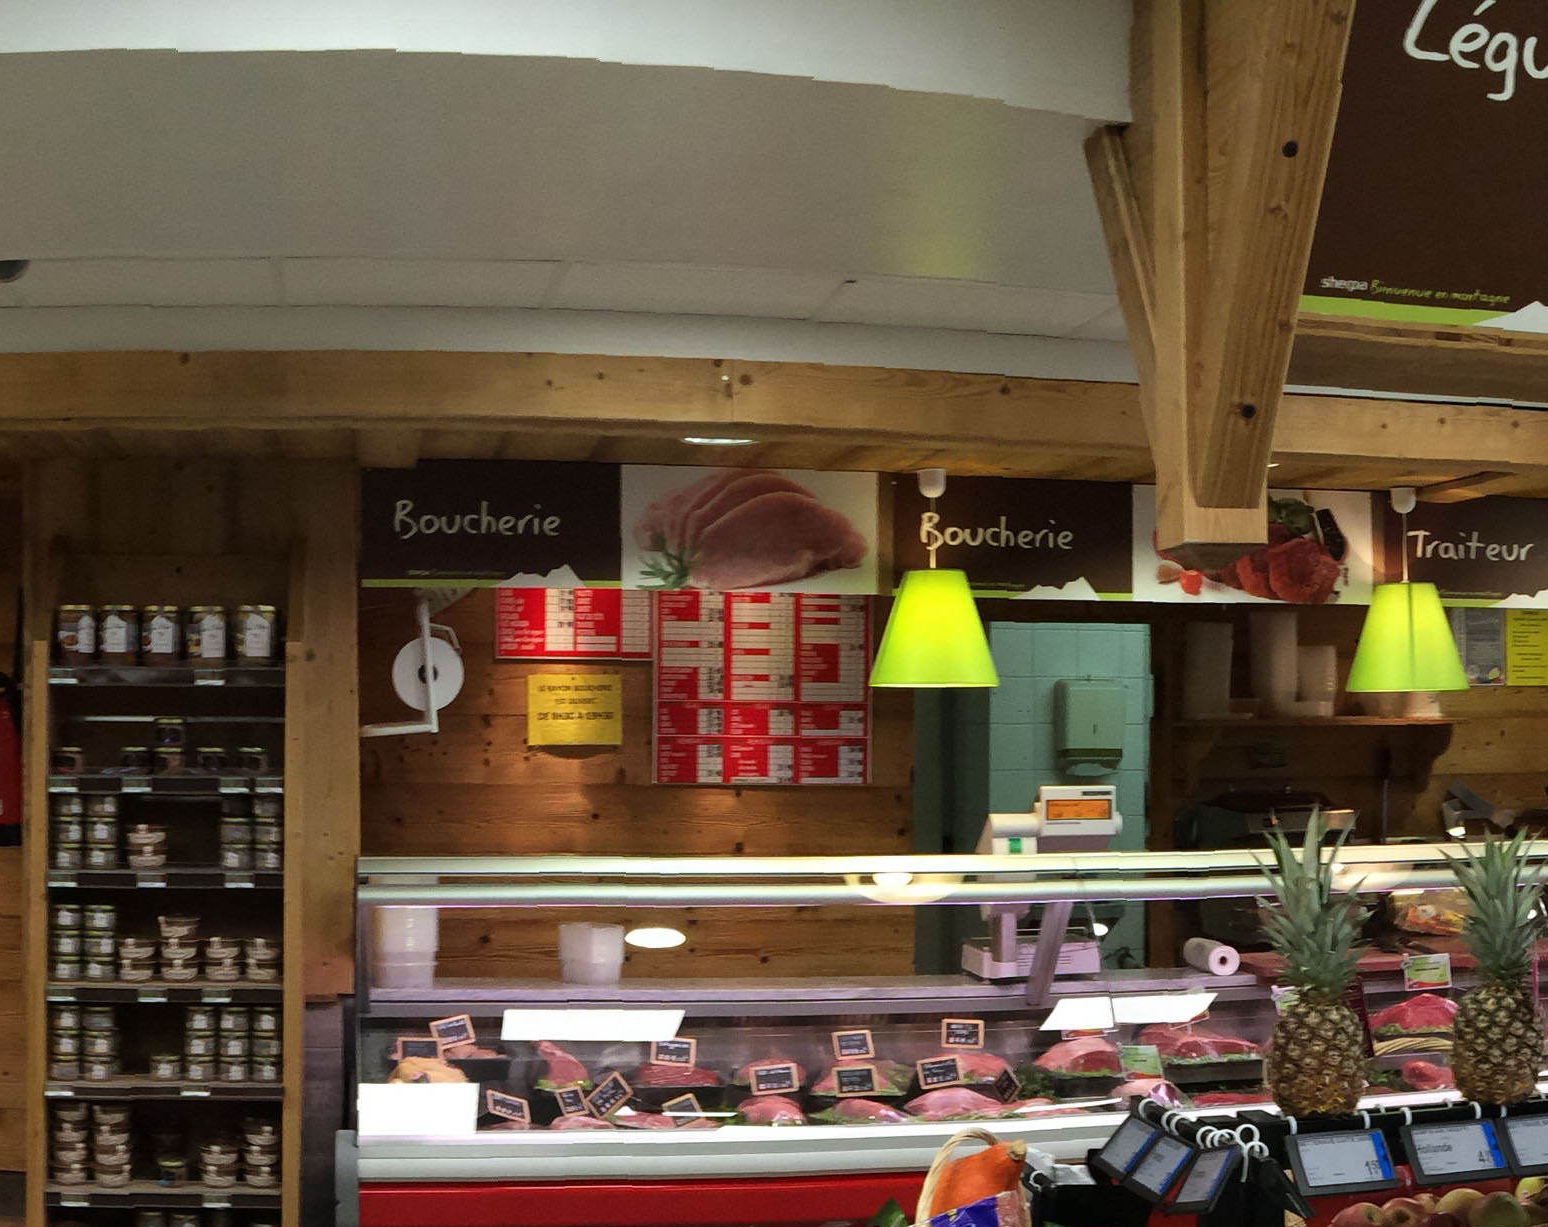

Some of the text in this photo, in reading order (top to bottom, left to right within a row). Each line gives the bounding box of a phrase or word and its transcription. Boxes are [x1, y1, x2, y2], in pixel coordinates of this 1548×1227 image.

[1321, 276, 1368, 291] sherpa
[394, 500, 561, 540] Boucherie
[920, 512, 1075, 550] Boucherie
[1407, 530, 1534, 561] Traiteur
